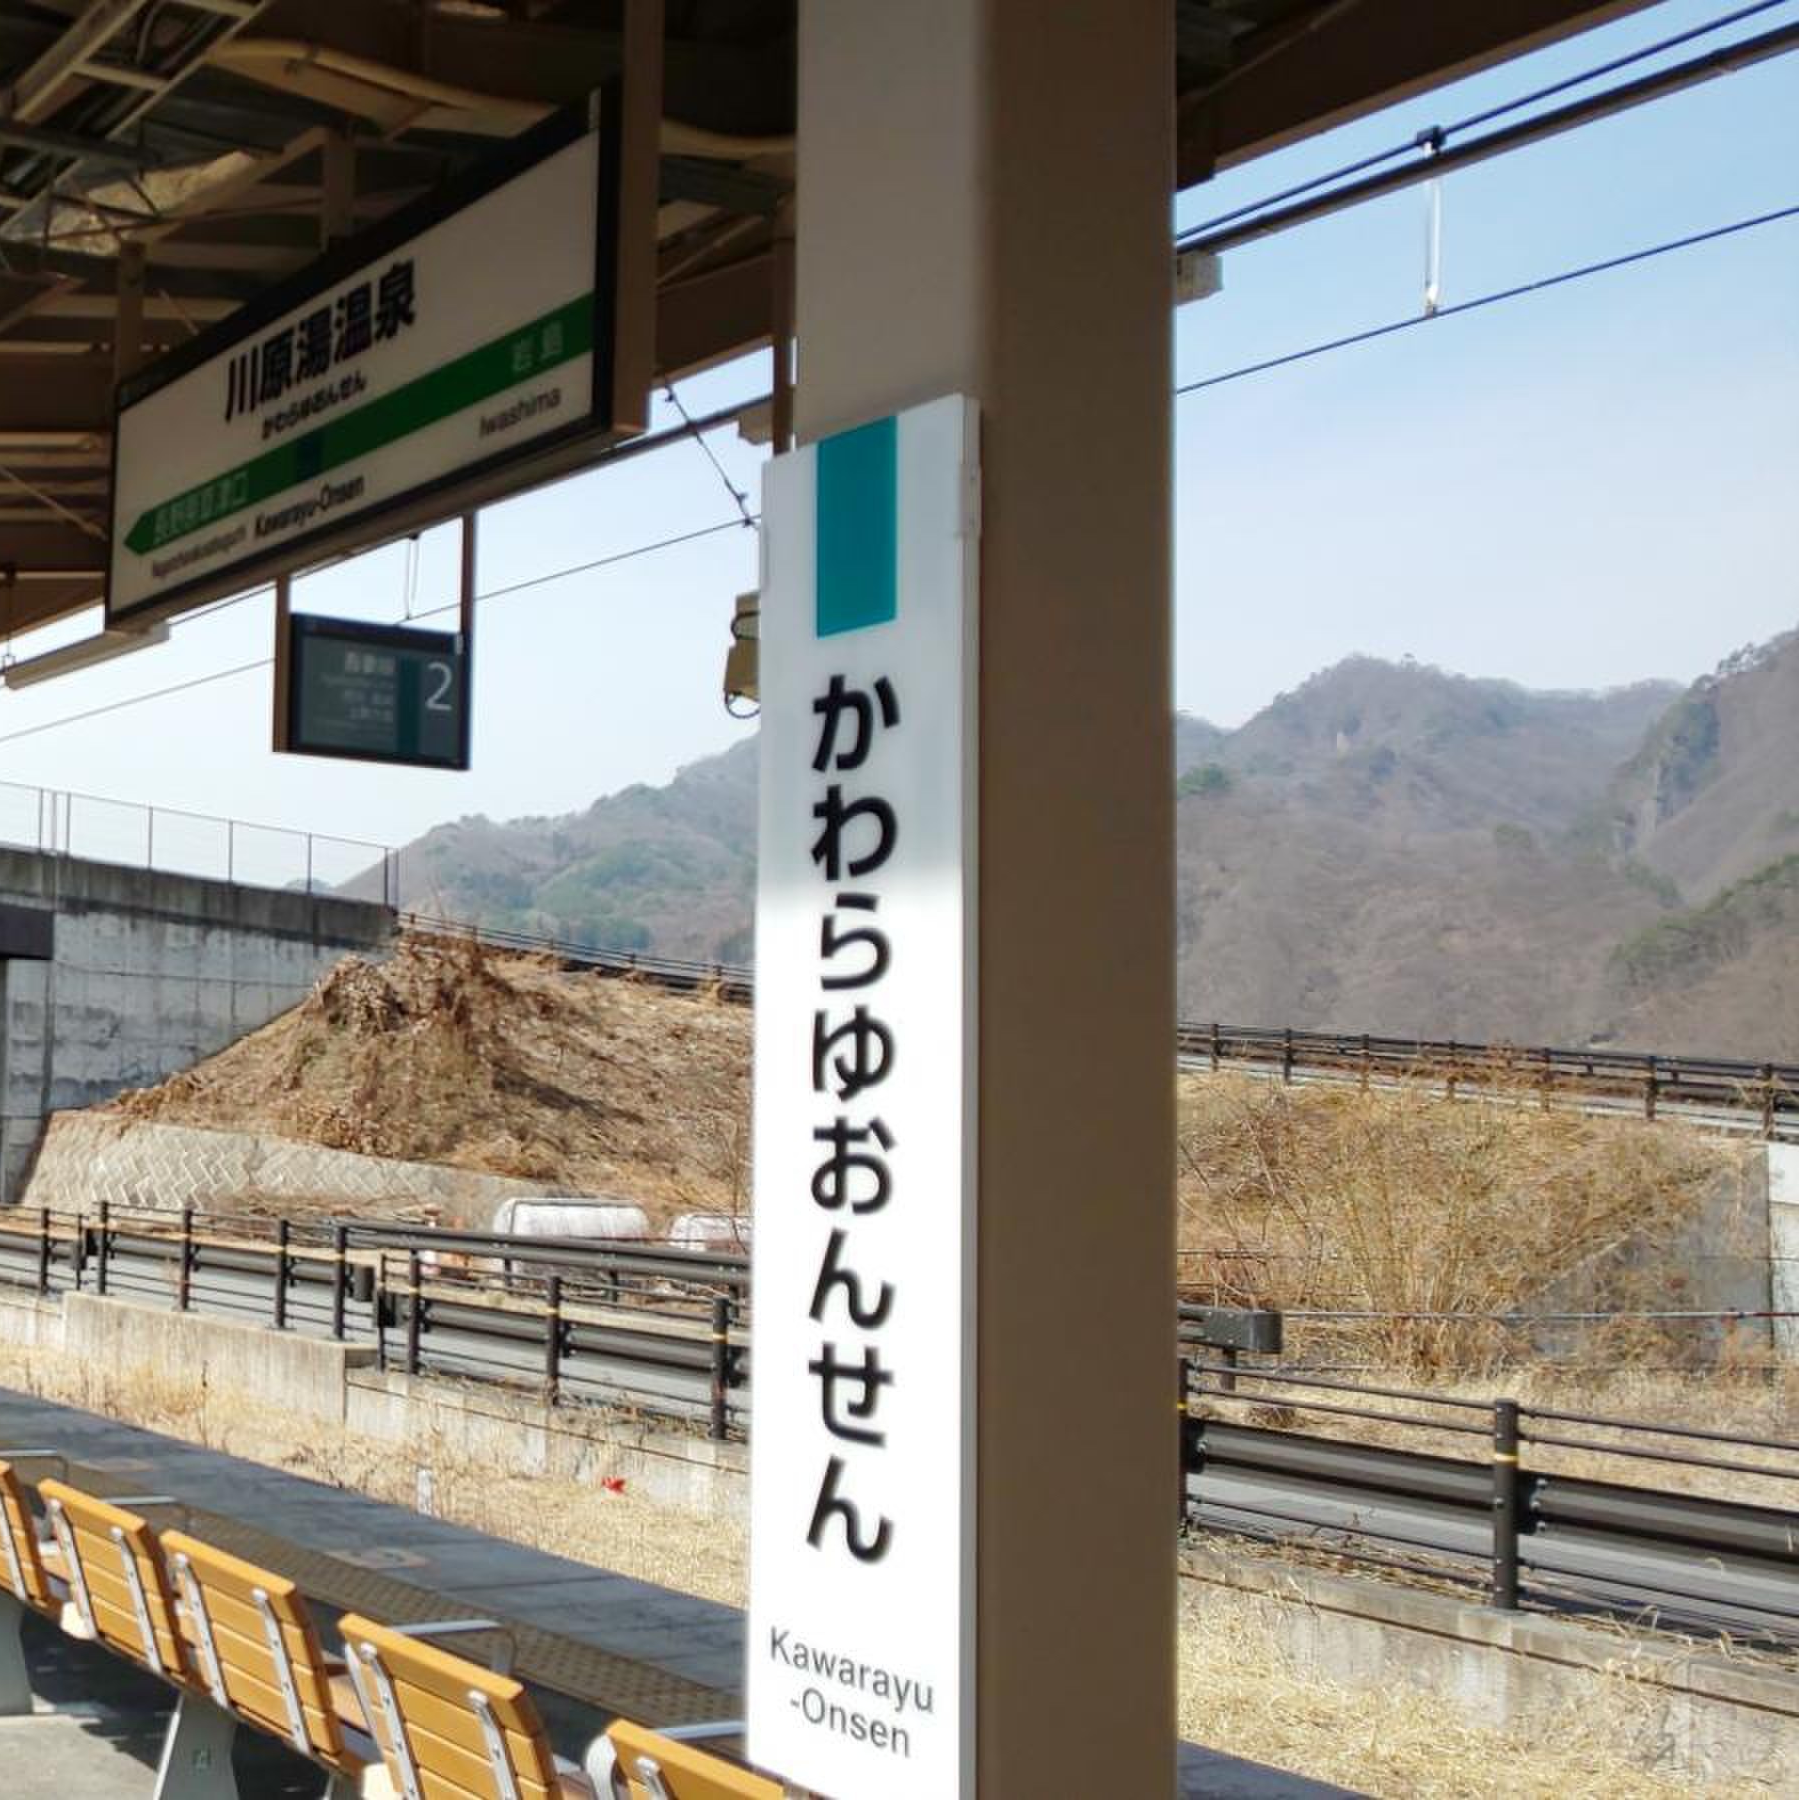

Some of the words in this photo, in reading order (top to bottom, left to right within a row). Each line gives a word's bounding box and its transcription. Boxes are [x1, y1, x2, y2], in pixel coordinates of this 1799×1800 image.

[225, 258, 416, 424] 川原湯温泉
[425, 661, 452, 711] 2
[806, 673, 900, 1564] かわらゆおんせん
[770, 1625, 934, 1713] Kawarayu
[789, 1686, 911, 1758] -Onsen
